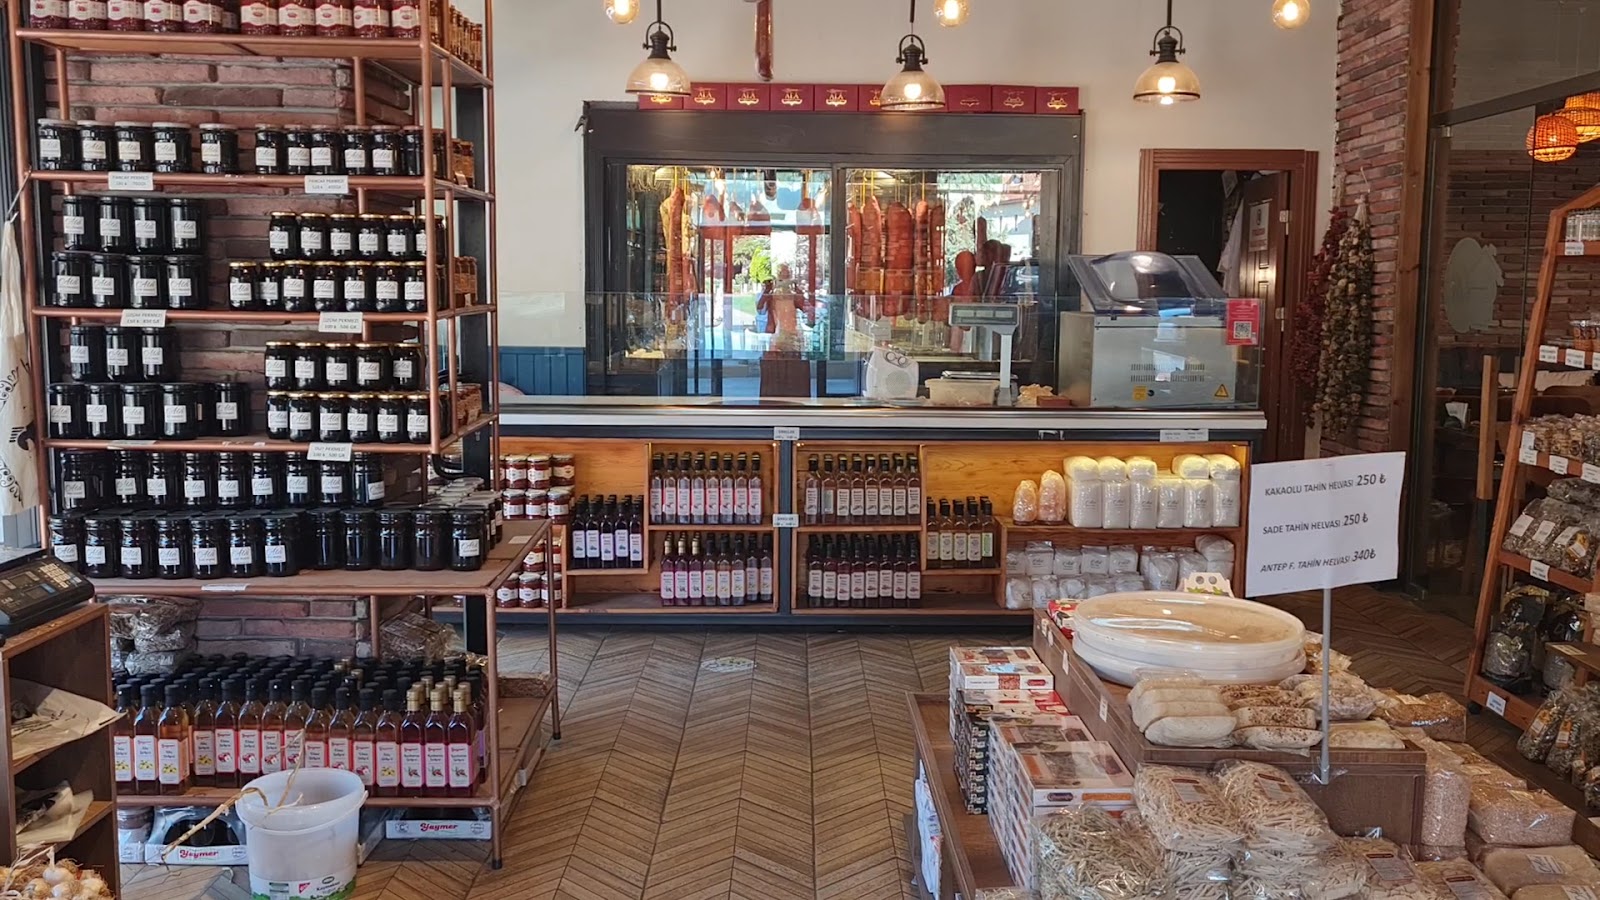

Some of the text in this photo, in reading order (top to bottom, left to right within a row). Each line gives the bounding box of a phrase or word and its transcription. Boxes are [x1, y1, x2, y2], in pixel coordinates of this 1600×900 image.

[1264, 485, 1302, 496] KAKAOLU
[1304, 482, 1326, 492] TAHİN
[1328, 480, 1353, 490] HELVASI
[1357, 474, 1376, 486] 250
[1262, 525, 1284, 534] SADE
[1285, 522, 1310, 532] TAHİN
[1311, 520, 1340, 530] HELVASI
[1343, 513, 1360, 526] 250
[1260, 562, 1288, 573] ANTEP
[1298, 559, 1322, 569] TAHİN
[1322, 556, 1351, 566] HELVASI
[420, 823, 458, 832] Yaymer
[180, 849, 219, 858] Yaymer
